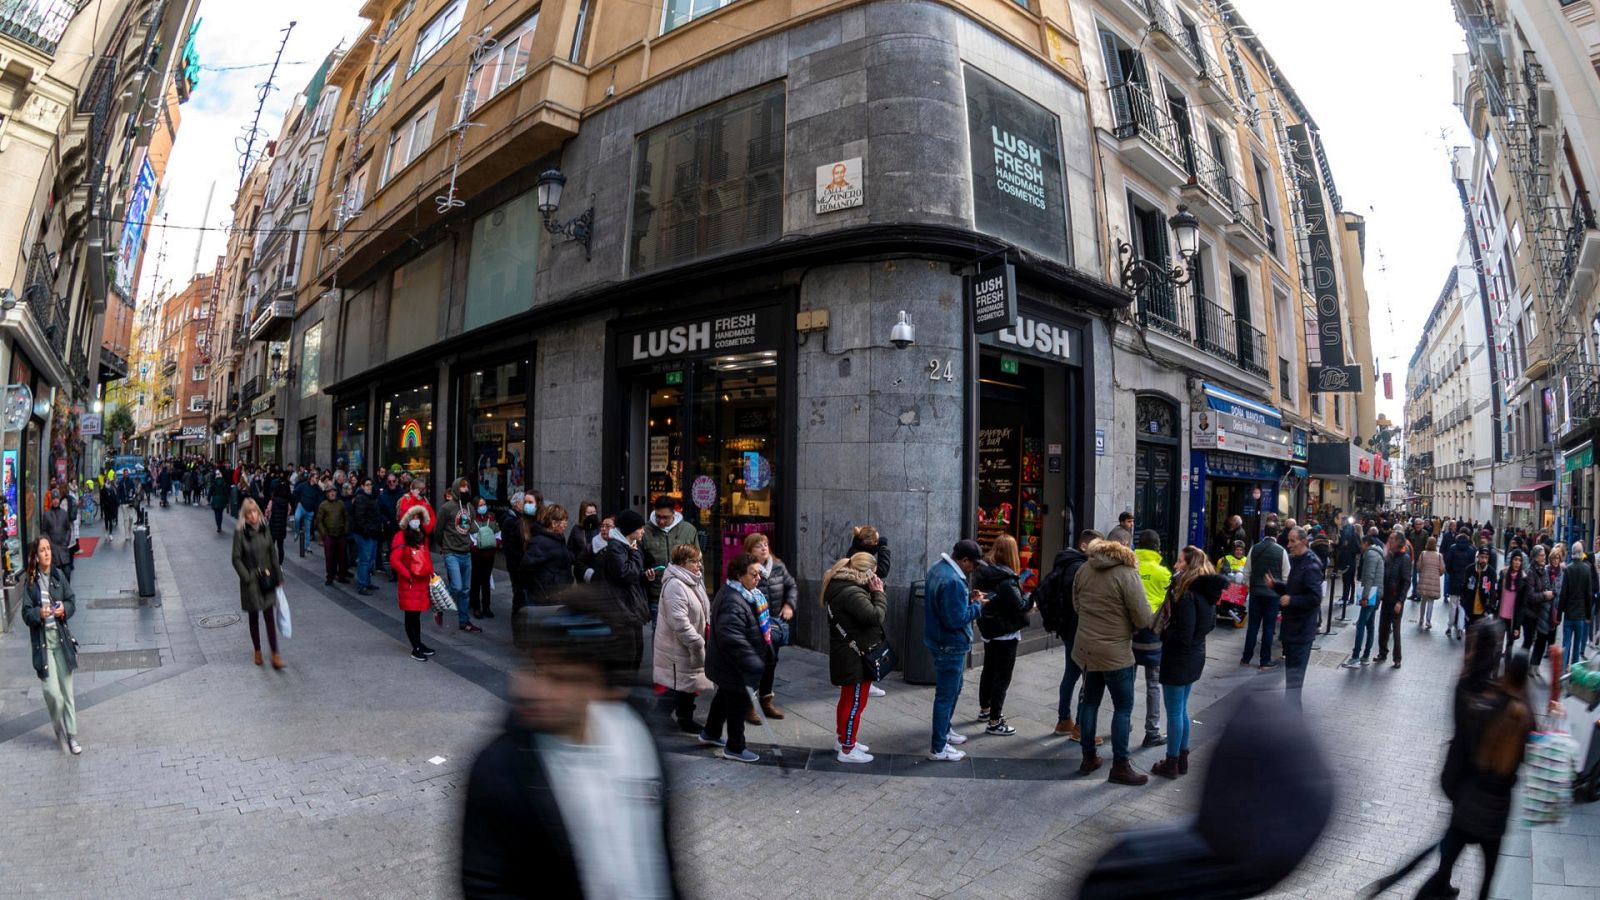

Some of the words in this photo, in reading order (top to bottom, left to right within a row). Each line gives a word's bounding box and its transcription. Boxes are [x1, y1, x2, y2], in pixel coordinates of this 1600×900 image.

[992, 125, 1042, 167] LUSH
[994, 147, 1044, 186] FRESH
[996, 167, 1045, 198] HANDMADE
[817, 189, 862, 204] MESONERO
[820, 198, 858, 212] ROMANOS
[997, 181, 1046, 210] COSMETICS
[1295, 140, 1340, 346] CALZADOS
[975, 275, 1003, 296] LUSH
[976, 290, 1004, 308] FRESH
[977, 302, 1004, 315] HANDMADE
[715, 313, 756, 331] FRESH
[977, 310, 1004, 323] COSMETICS
[632, 321, 711, 360] LUSH
[715, 327, 756, 340] HANDMADE
[715, 336, 756, 348] COSMETICS
[929, 359, 954, 382] 24
